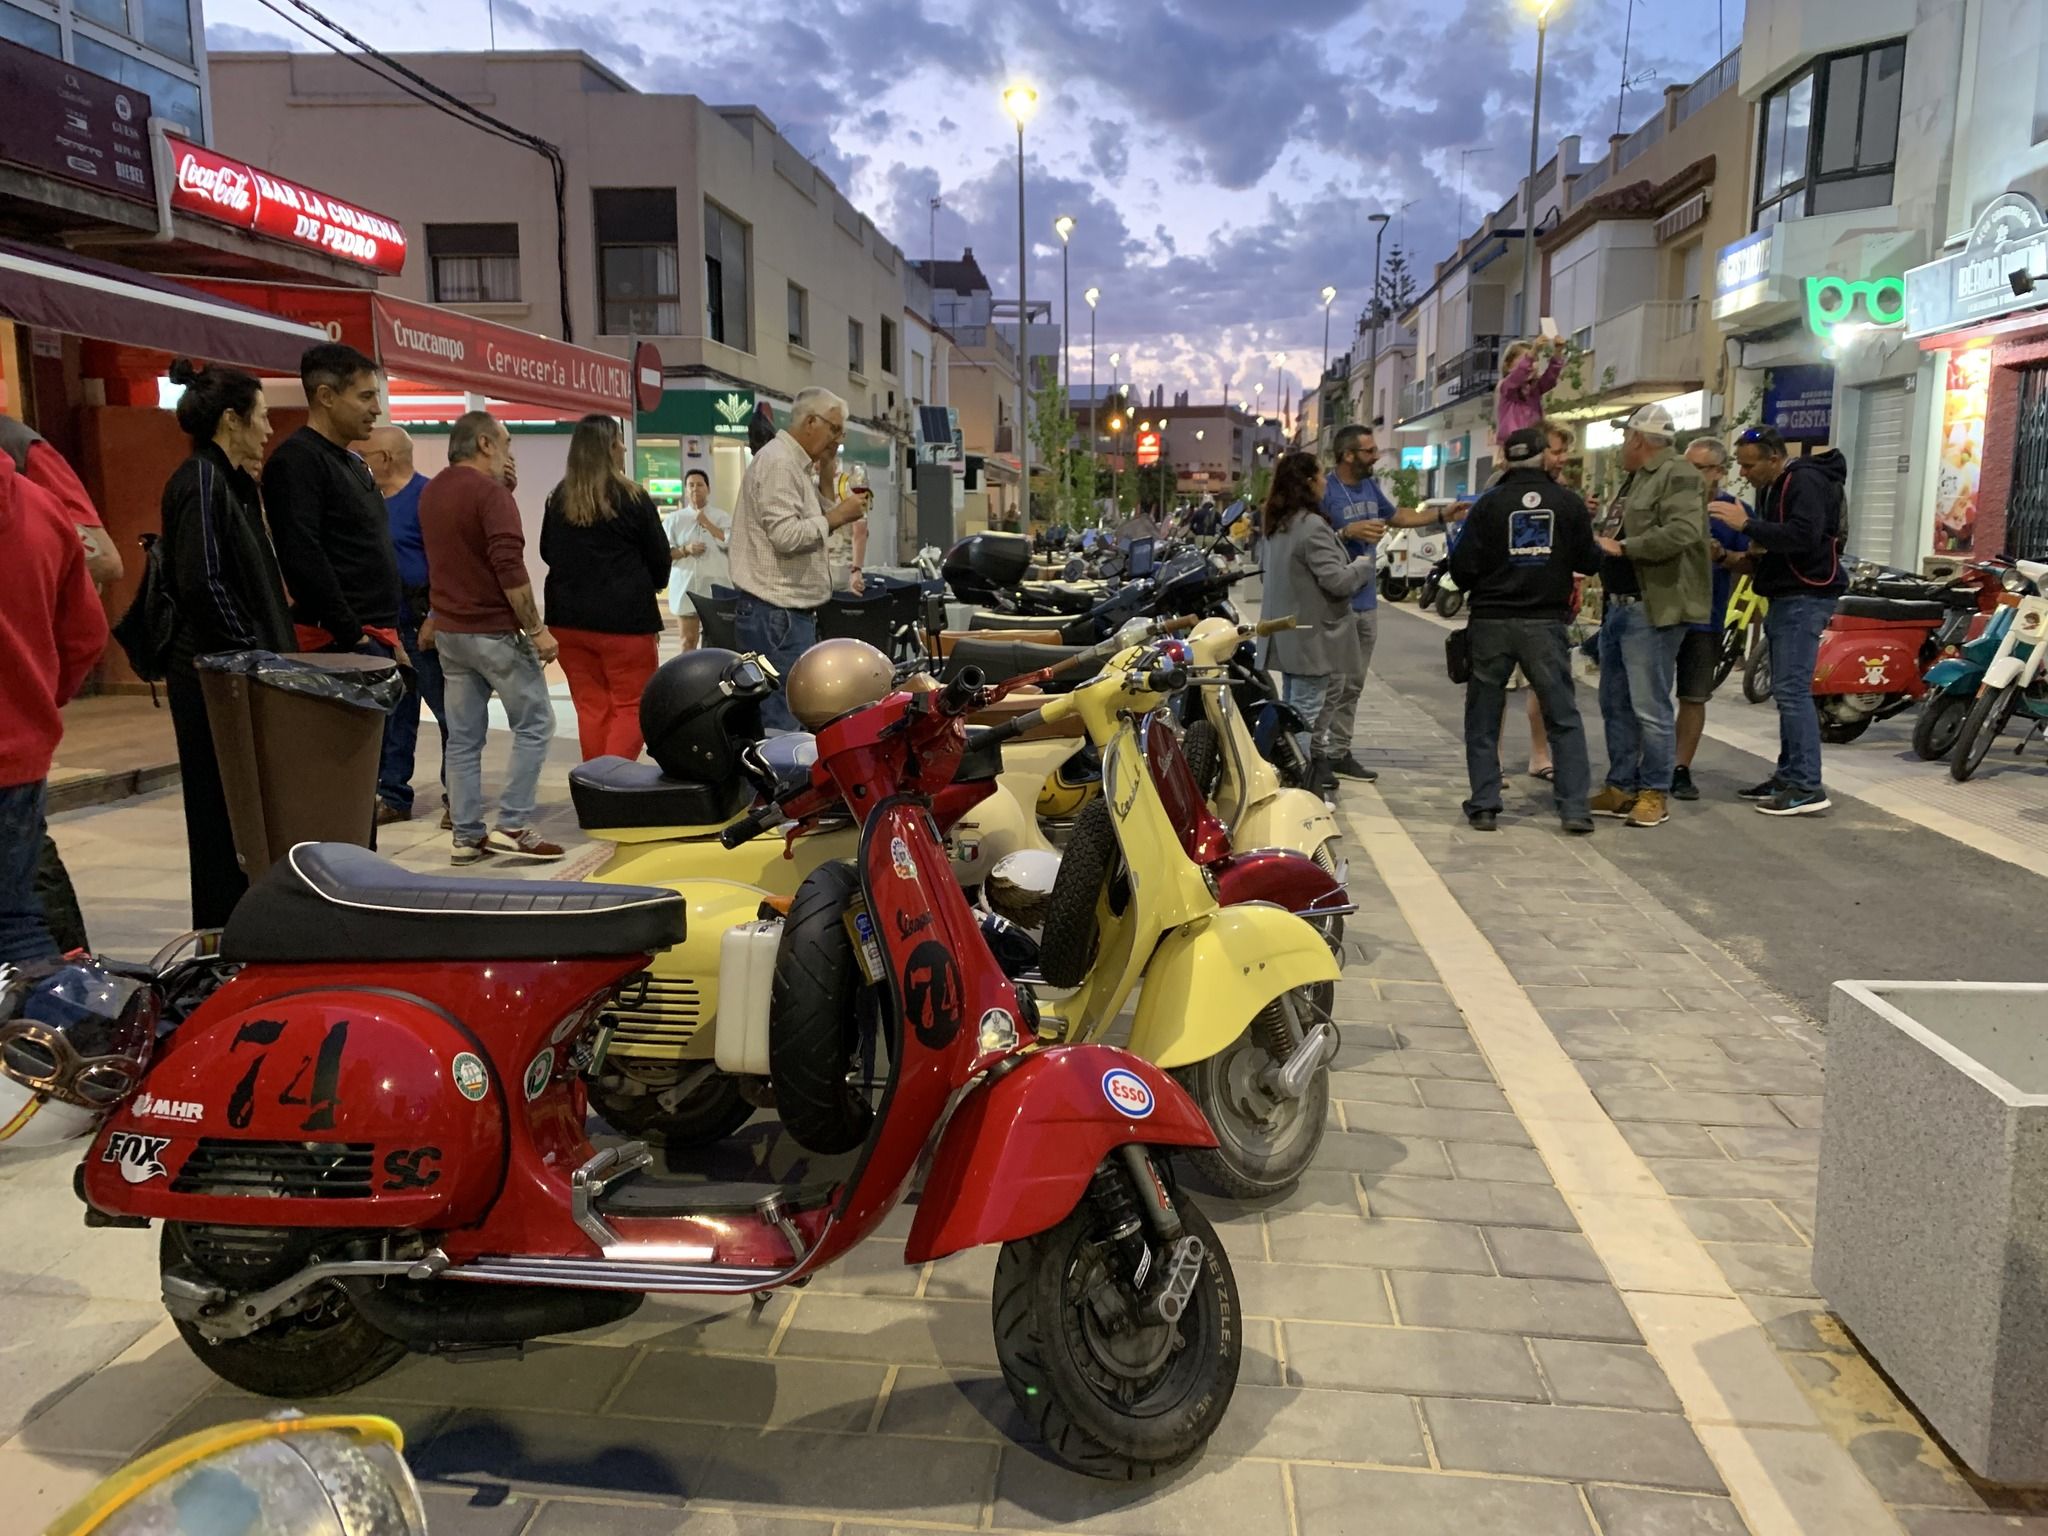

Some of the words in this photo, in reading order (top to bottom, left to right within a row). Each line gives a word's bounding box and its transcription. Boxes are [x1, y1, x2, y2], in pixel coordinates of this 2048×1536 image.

[112, 121, 140, 139] GUESS
[115, 161, 145, 184] DIESEL
[257, 174, 301, 210] BAR
[299, 191, 328, 219] LA
[327, 202, 404, 246] COLMENA
[293, 214, 319, 241] DE
[320, 226, 377, 260] PEDRO
[394, 319, 465, 362] Cruzcampo
[486, 342, 566, 385] Cervecería
[571, 359, 586, 390] LA
[1508, 546, 1552, 556] vespa
[910, 961, 958, 1029] 74
[226, 1018, 350, 1131] 74
[151, 1099, 204, 1120] MHR
[104, 1132, 170, 1167] FOX
[383, 1145, 443, 1190] SC
[1204, 1246, 1232, 1359] METZELER
